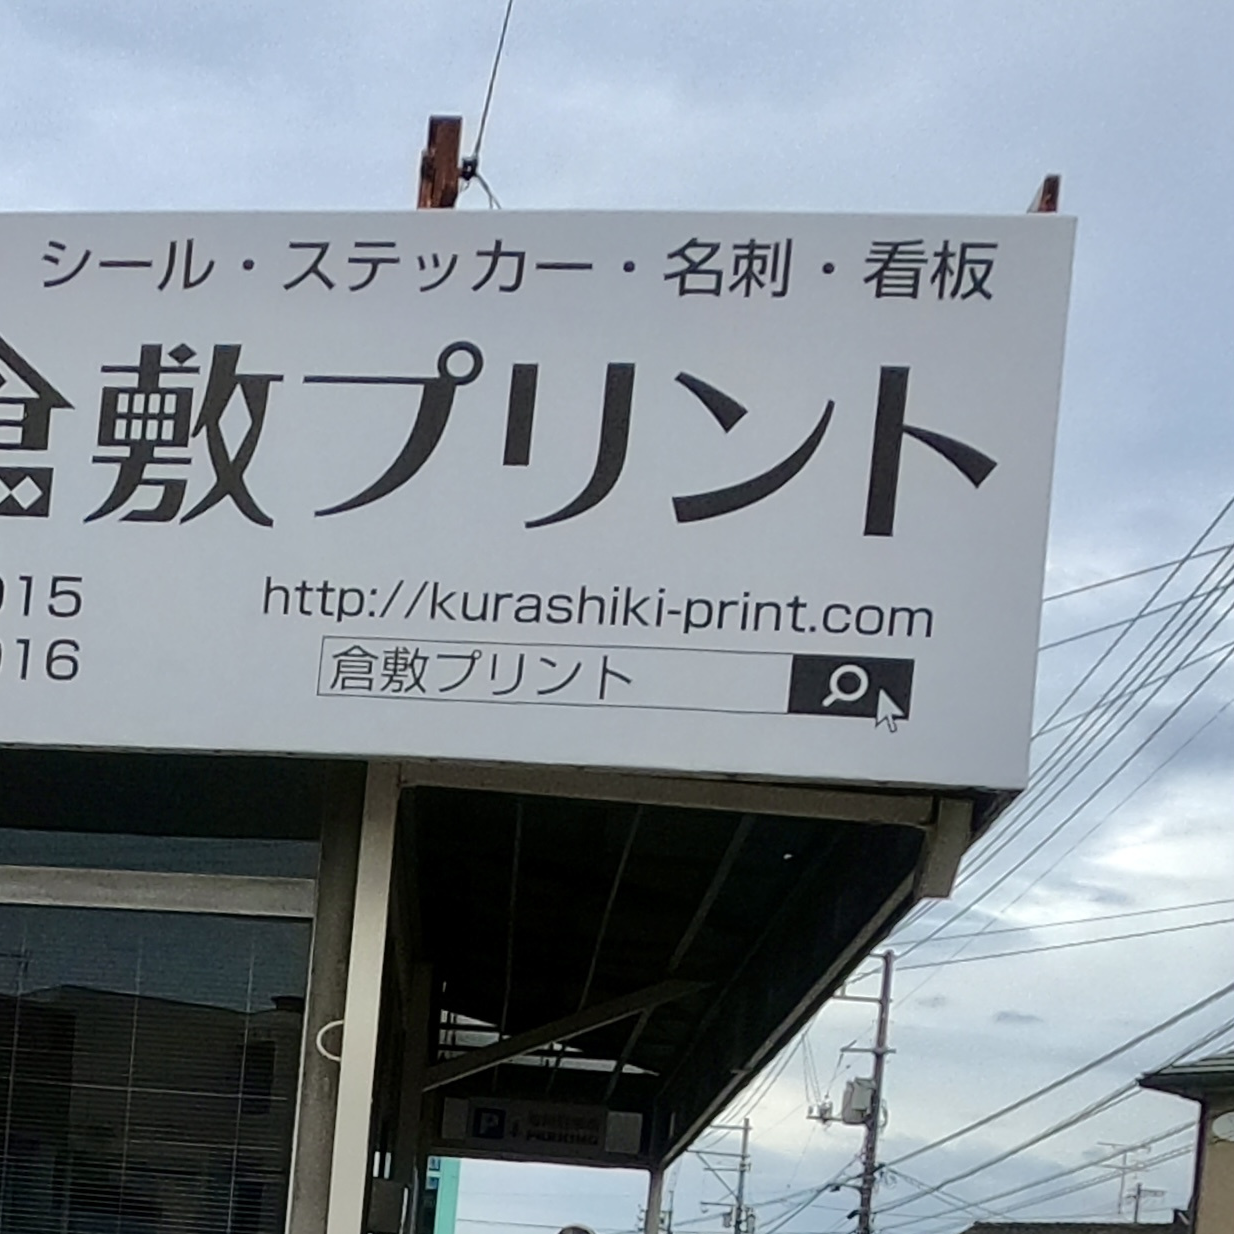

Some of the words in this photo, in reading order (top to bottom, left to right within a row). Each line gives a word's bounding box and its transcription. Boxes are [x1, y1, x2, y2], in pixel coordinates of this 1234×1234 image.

[263, 575, 934, 639] http://kurashiki-print.com
[329, 644, 634, 701] 倉敷プリント
